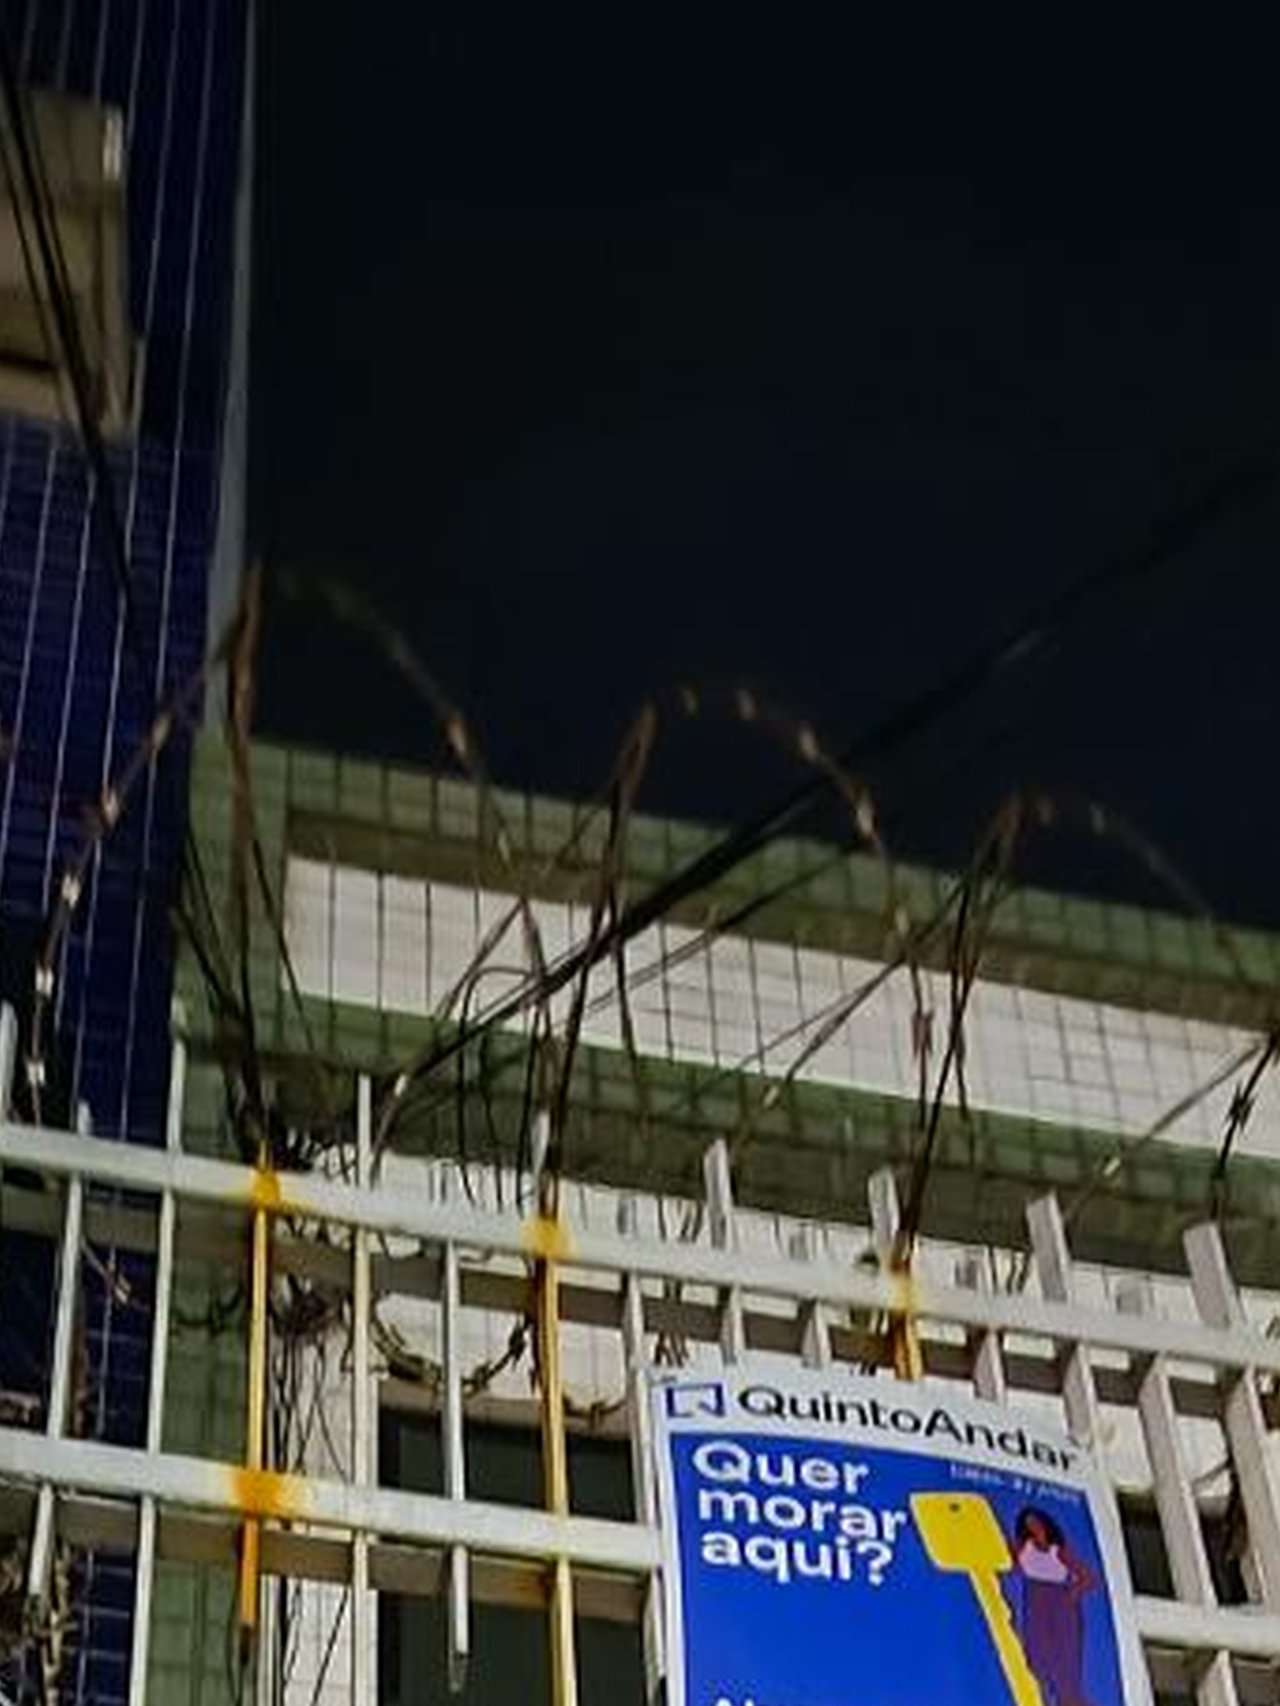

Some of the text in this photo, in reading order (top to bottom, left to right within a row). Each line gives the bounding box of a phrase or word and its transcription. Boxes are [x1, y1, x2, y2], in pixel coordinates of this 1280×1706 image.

[738, 1385, 1078, 1471] QuintoAndar
[692, 1441, 870, 1495] Quer
[698, 1490, 908, 1543] morar
[701, 1530, 893, 1585] aqui?
